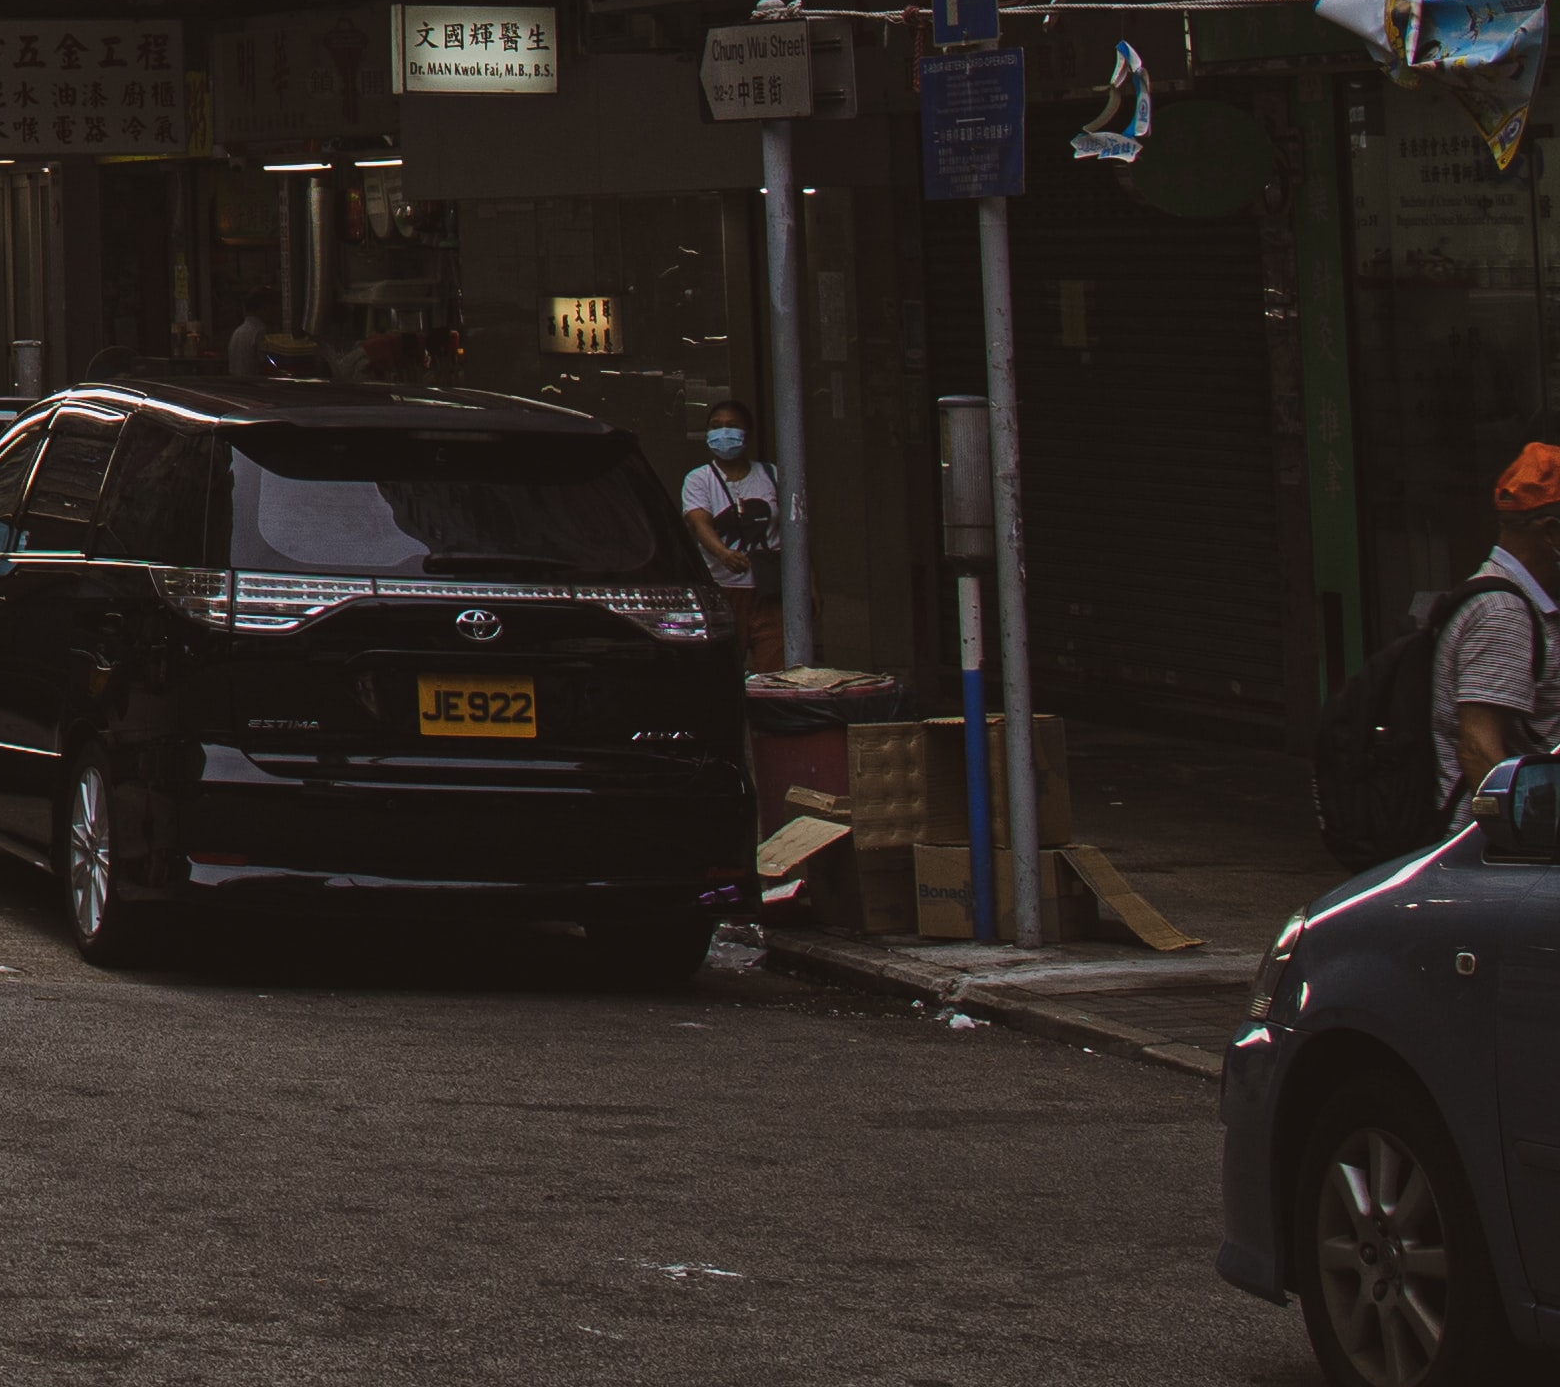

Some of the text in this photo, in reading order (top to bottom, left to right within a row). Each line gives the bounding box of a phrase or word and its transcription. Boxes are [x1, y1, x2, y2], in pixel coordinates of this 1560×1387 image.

[414, 21, 550, 52] 文國輝醫生
[712, 34, 805, 64] Chung Wui Street
[410, 62, 425, 75] Dr.
[427, 62, 452, 76] MAN
[454, 63, 482, 77] Kwok
[484, 63, 503, 78] Fai,
[534, 64, 554, 77] B.S.
[51, 81, 108, 109] 油漆
[738, 75, 782, 107] 中匯街
[51, 115, 108, 144] 電器
[121, 115, 178, 144] 冷氣
[422, 691, 534, 724] JE 922
[247, 718, 320, 730] ESTIMA
